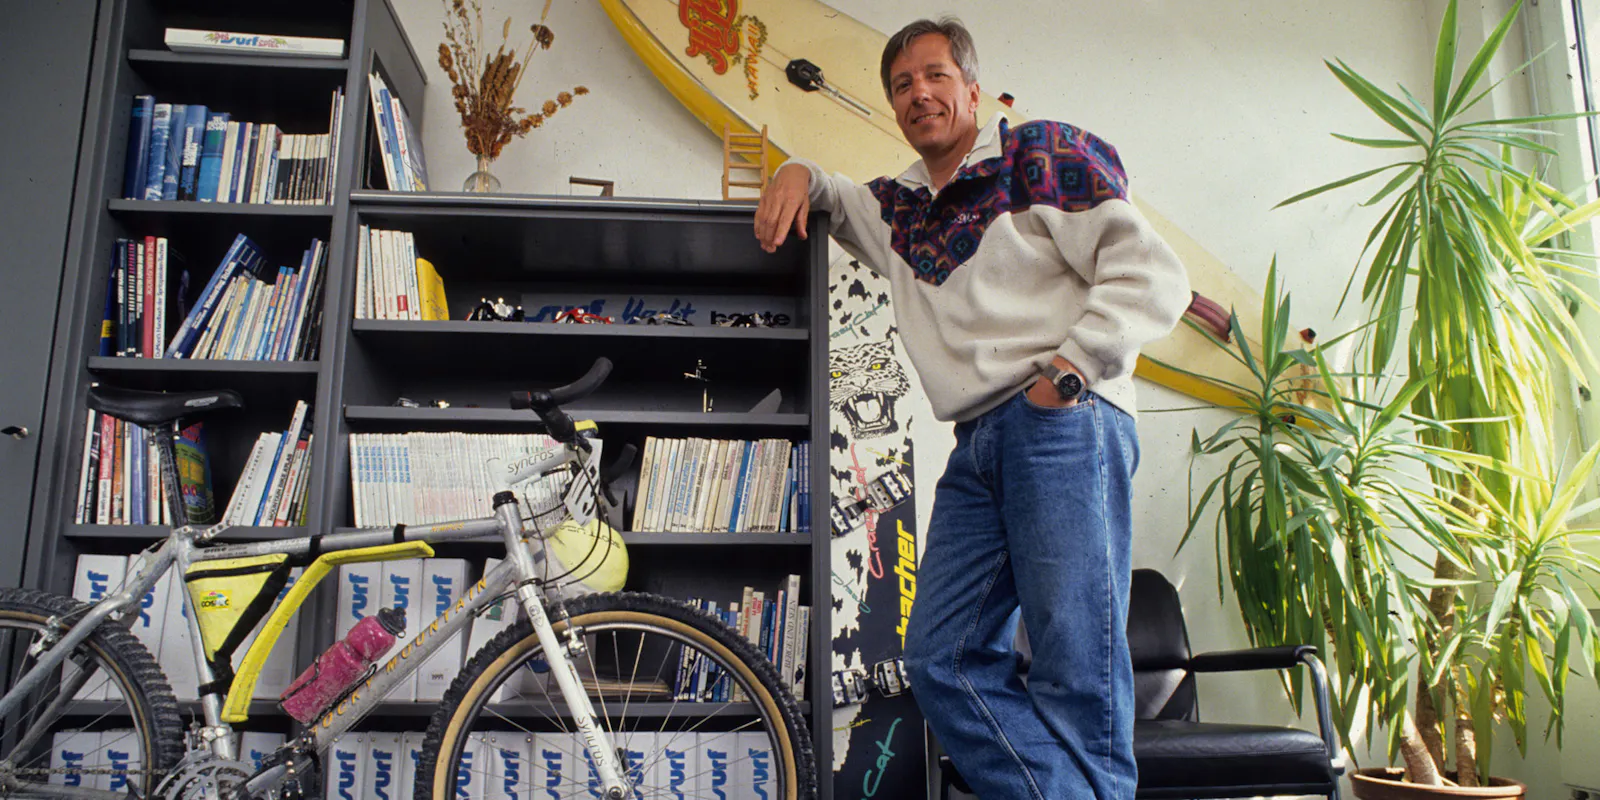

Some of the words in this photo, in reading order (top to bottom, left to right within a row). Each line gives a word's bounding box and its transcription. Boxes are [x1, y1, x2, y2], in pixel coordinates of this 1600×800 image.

[220, 36, 260, 46] surf
[747, 23, 761, 93] HAWAII
[267, 488, 283, 521] MOUNTAIN
[278, 473, 287, 489] BIKE
[283, 453, 293, 473] ATLAS
[507, 449, 555, 476] syncros
[681, 462, 690, 483] surfen
[87, 570, 108, 607] urf
[348, 573, 369, 621] surf
[432, 574, 452, 618] urf
[385, 574, 489, 674] MOUNTAIN
[787, 621, 795, 640] UND
[784, 641, 794, 668] BERGE
[336, 750, 357, 800] surf
[371, 750, 393, 800] surf
[500, 748, 520, 800] surf
[542, 749, 562, 800] surf
[665, 748, 685, 800] surf
[707, 748, 728, 800] surf
[748, 748, 769, 800] surf
[862, 717, 902, 798] Cat
